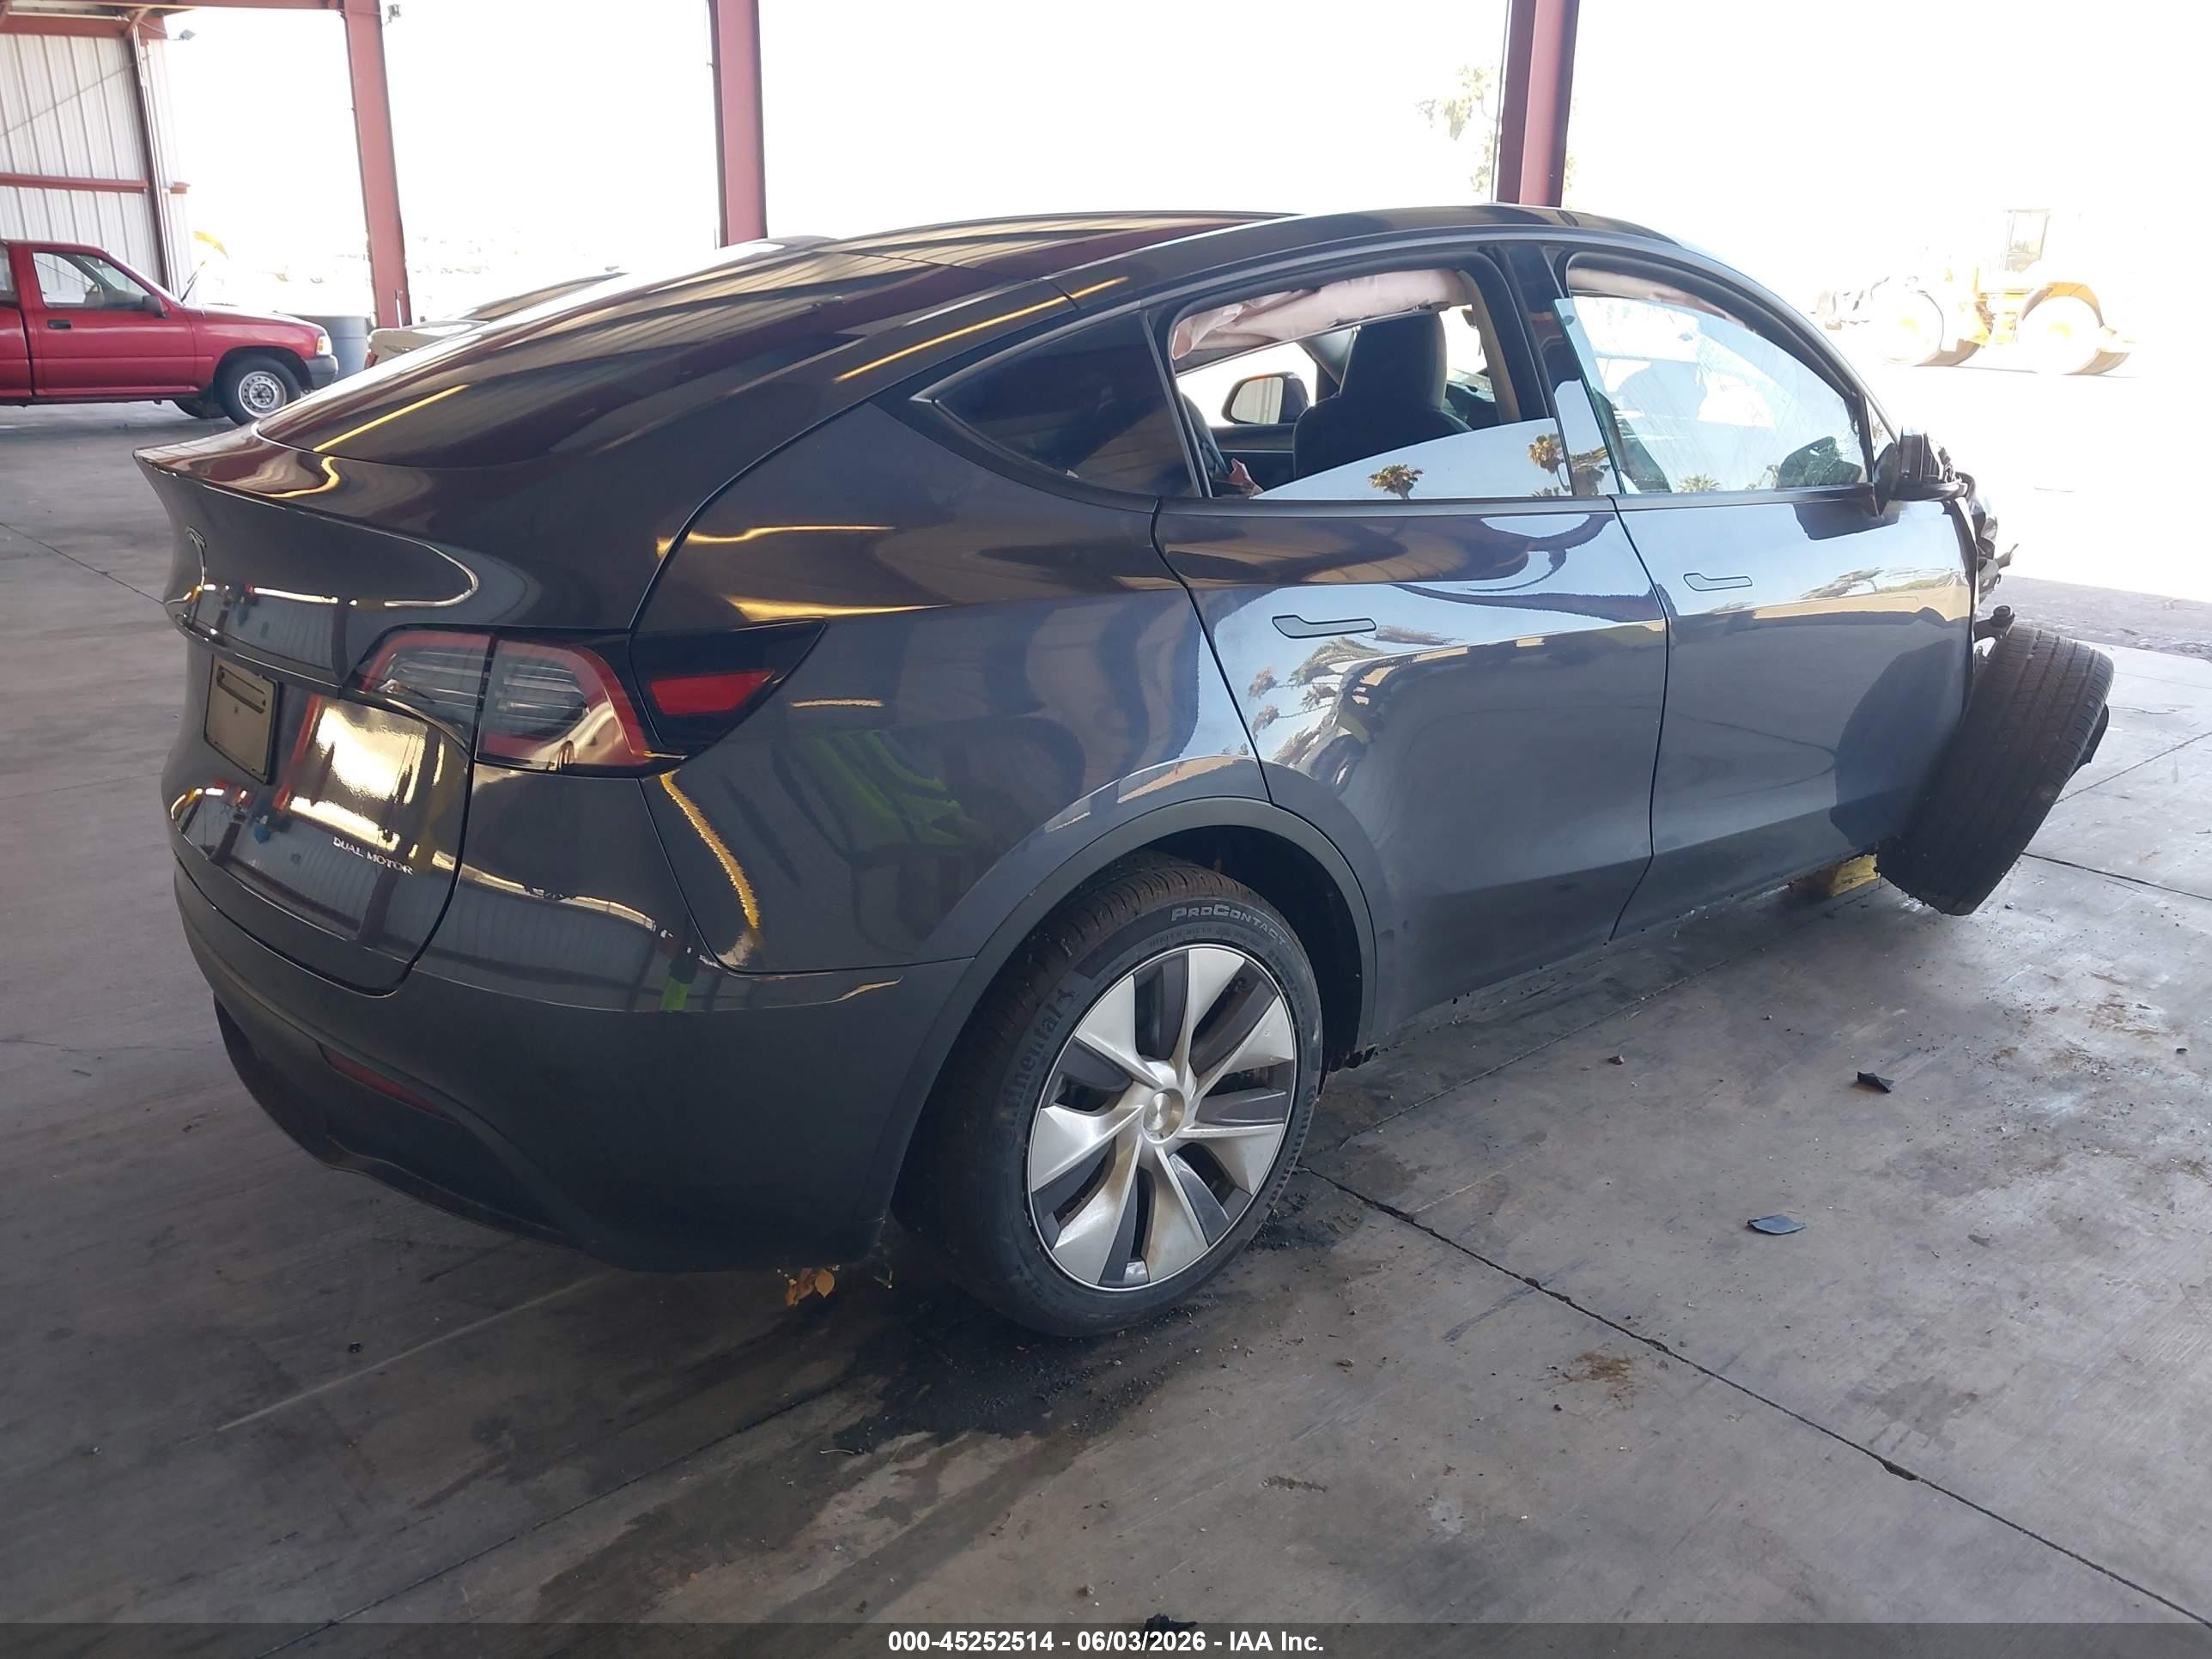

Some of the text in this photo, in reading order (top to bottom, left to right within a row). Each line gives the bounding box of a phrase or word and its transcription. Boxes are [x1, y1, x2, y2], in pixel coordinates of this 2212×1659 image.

[332, 836, 413, 875] DUAL MOTOR
[994, 1002, 1064, 1149] tinental
